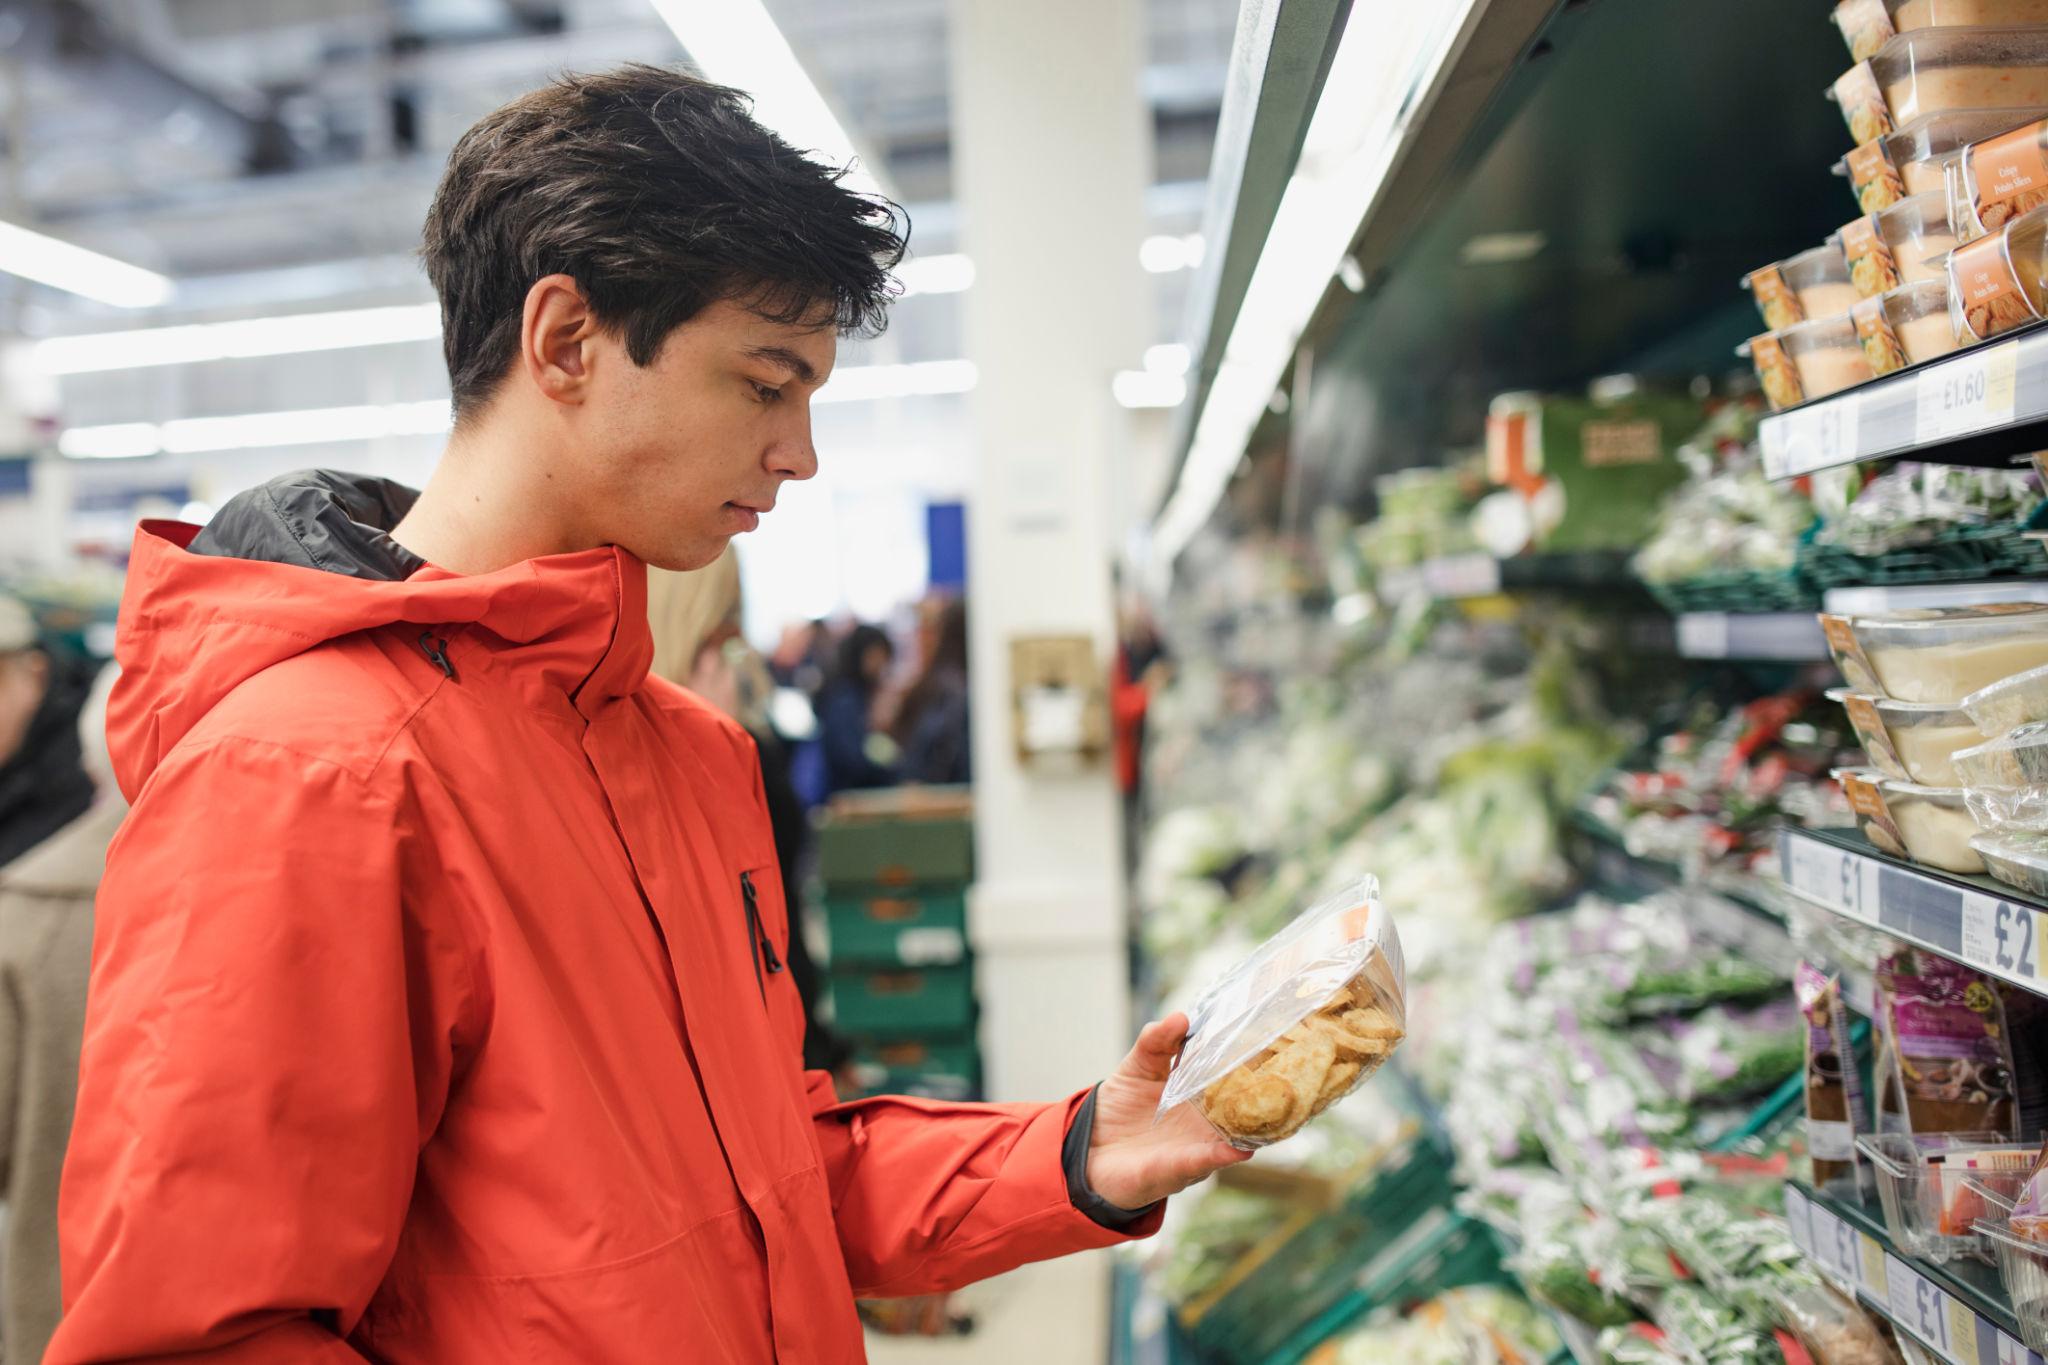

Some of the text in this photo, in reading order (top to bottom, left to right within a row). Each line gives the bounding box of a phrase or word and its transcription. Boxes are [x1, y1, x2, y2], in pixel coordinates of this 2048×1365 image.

[1944, 369, 1986, 410] £1.60
[1819, 407, 1842, 456] £1
[1841, 853, 1862, 911] £1
[1995, 901, 2034, 978] £2
[1836, 1219, 1862, 1282] £1
[1916, 1277, 1947, 1351] £1
